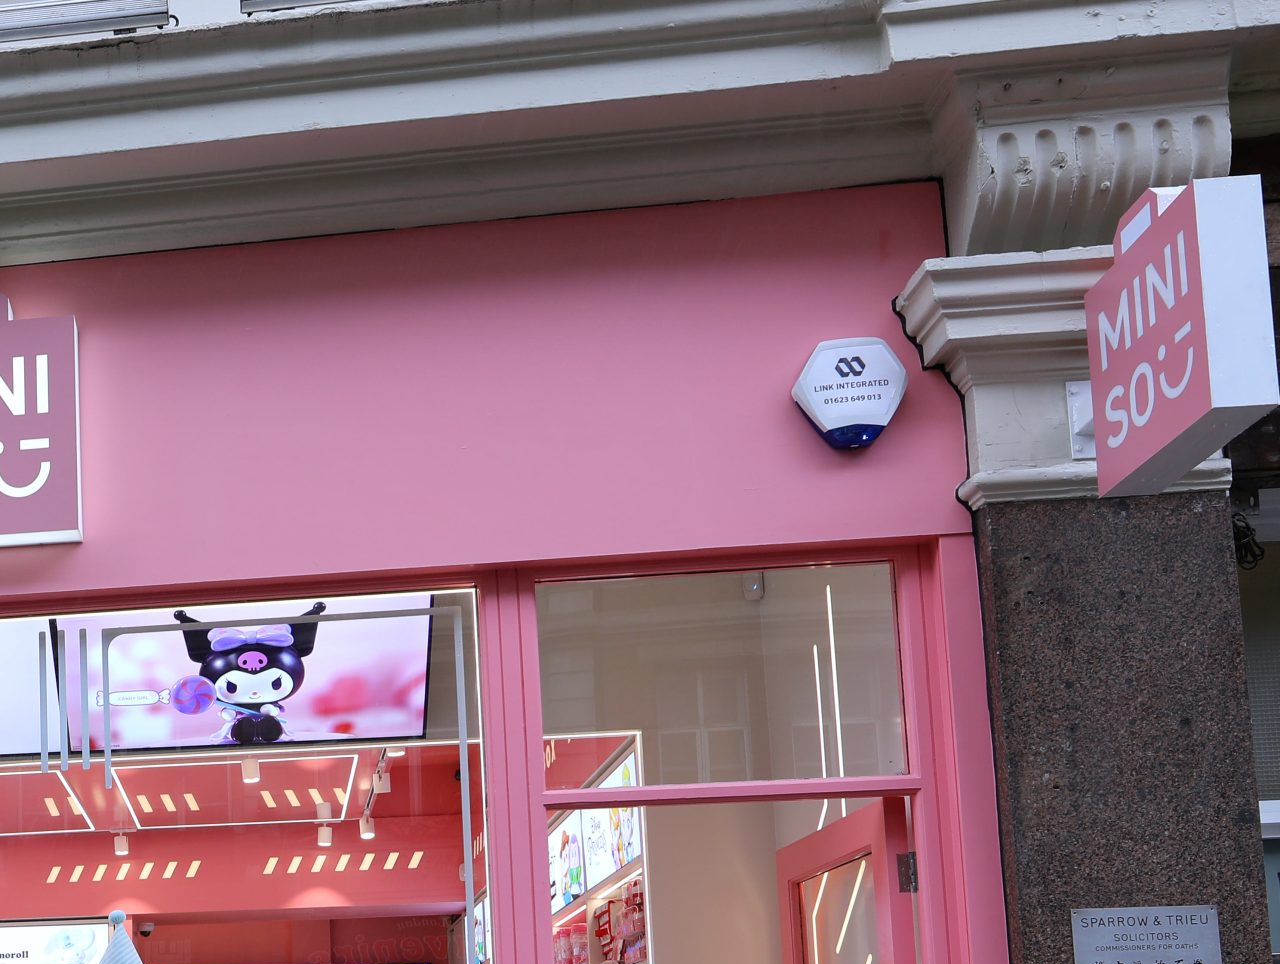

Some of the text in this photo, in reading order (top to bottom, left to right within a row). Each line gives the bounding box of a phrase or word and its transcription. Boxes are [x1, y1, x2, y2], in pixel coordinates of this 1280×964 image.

[1097, 229, 1189, 372] MINI
[814, 379, 889, 393] LINK INTEGRATED
[824, 393, 882, 405] 01623 649 013
[1080, 914, 1209, 928] SPARROW & TRIEU
[1113, 932, 1179, 942] SOLICITORS
[1095, 942, 1199, 952] COMMISSIONERS FOR OATHS
